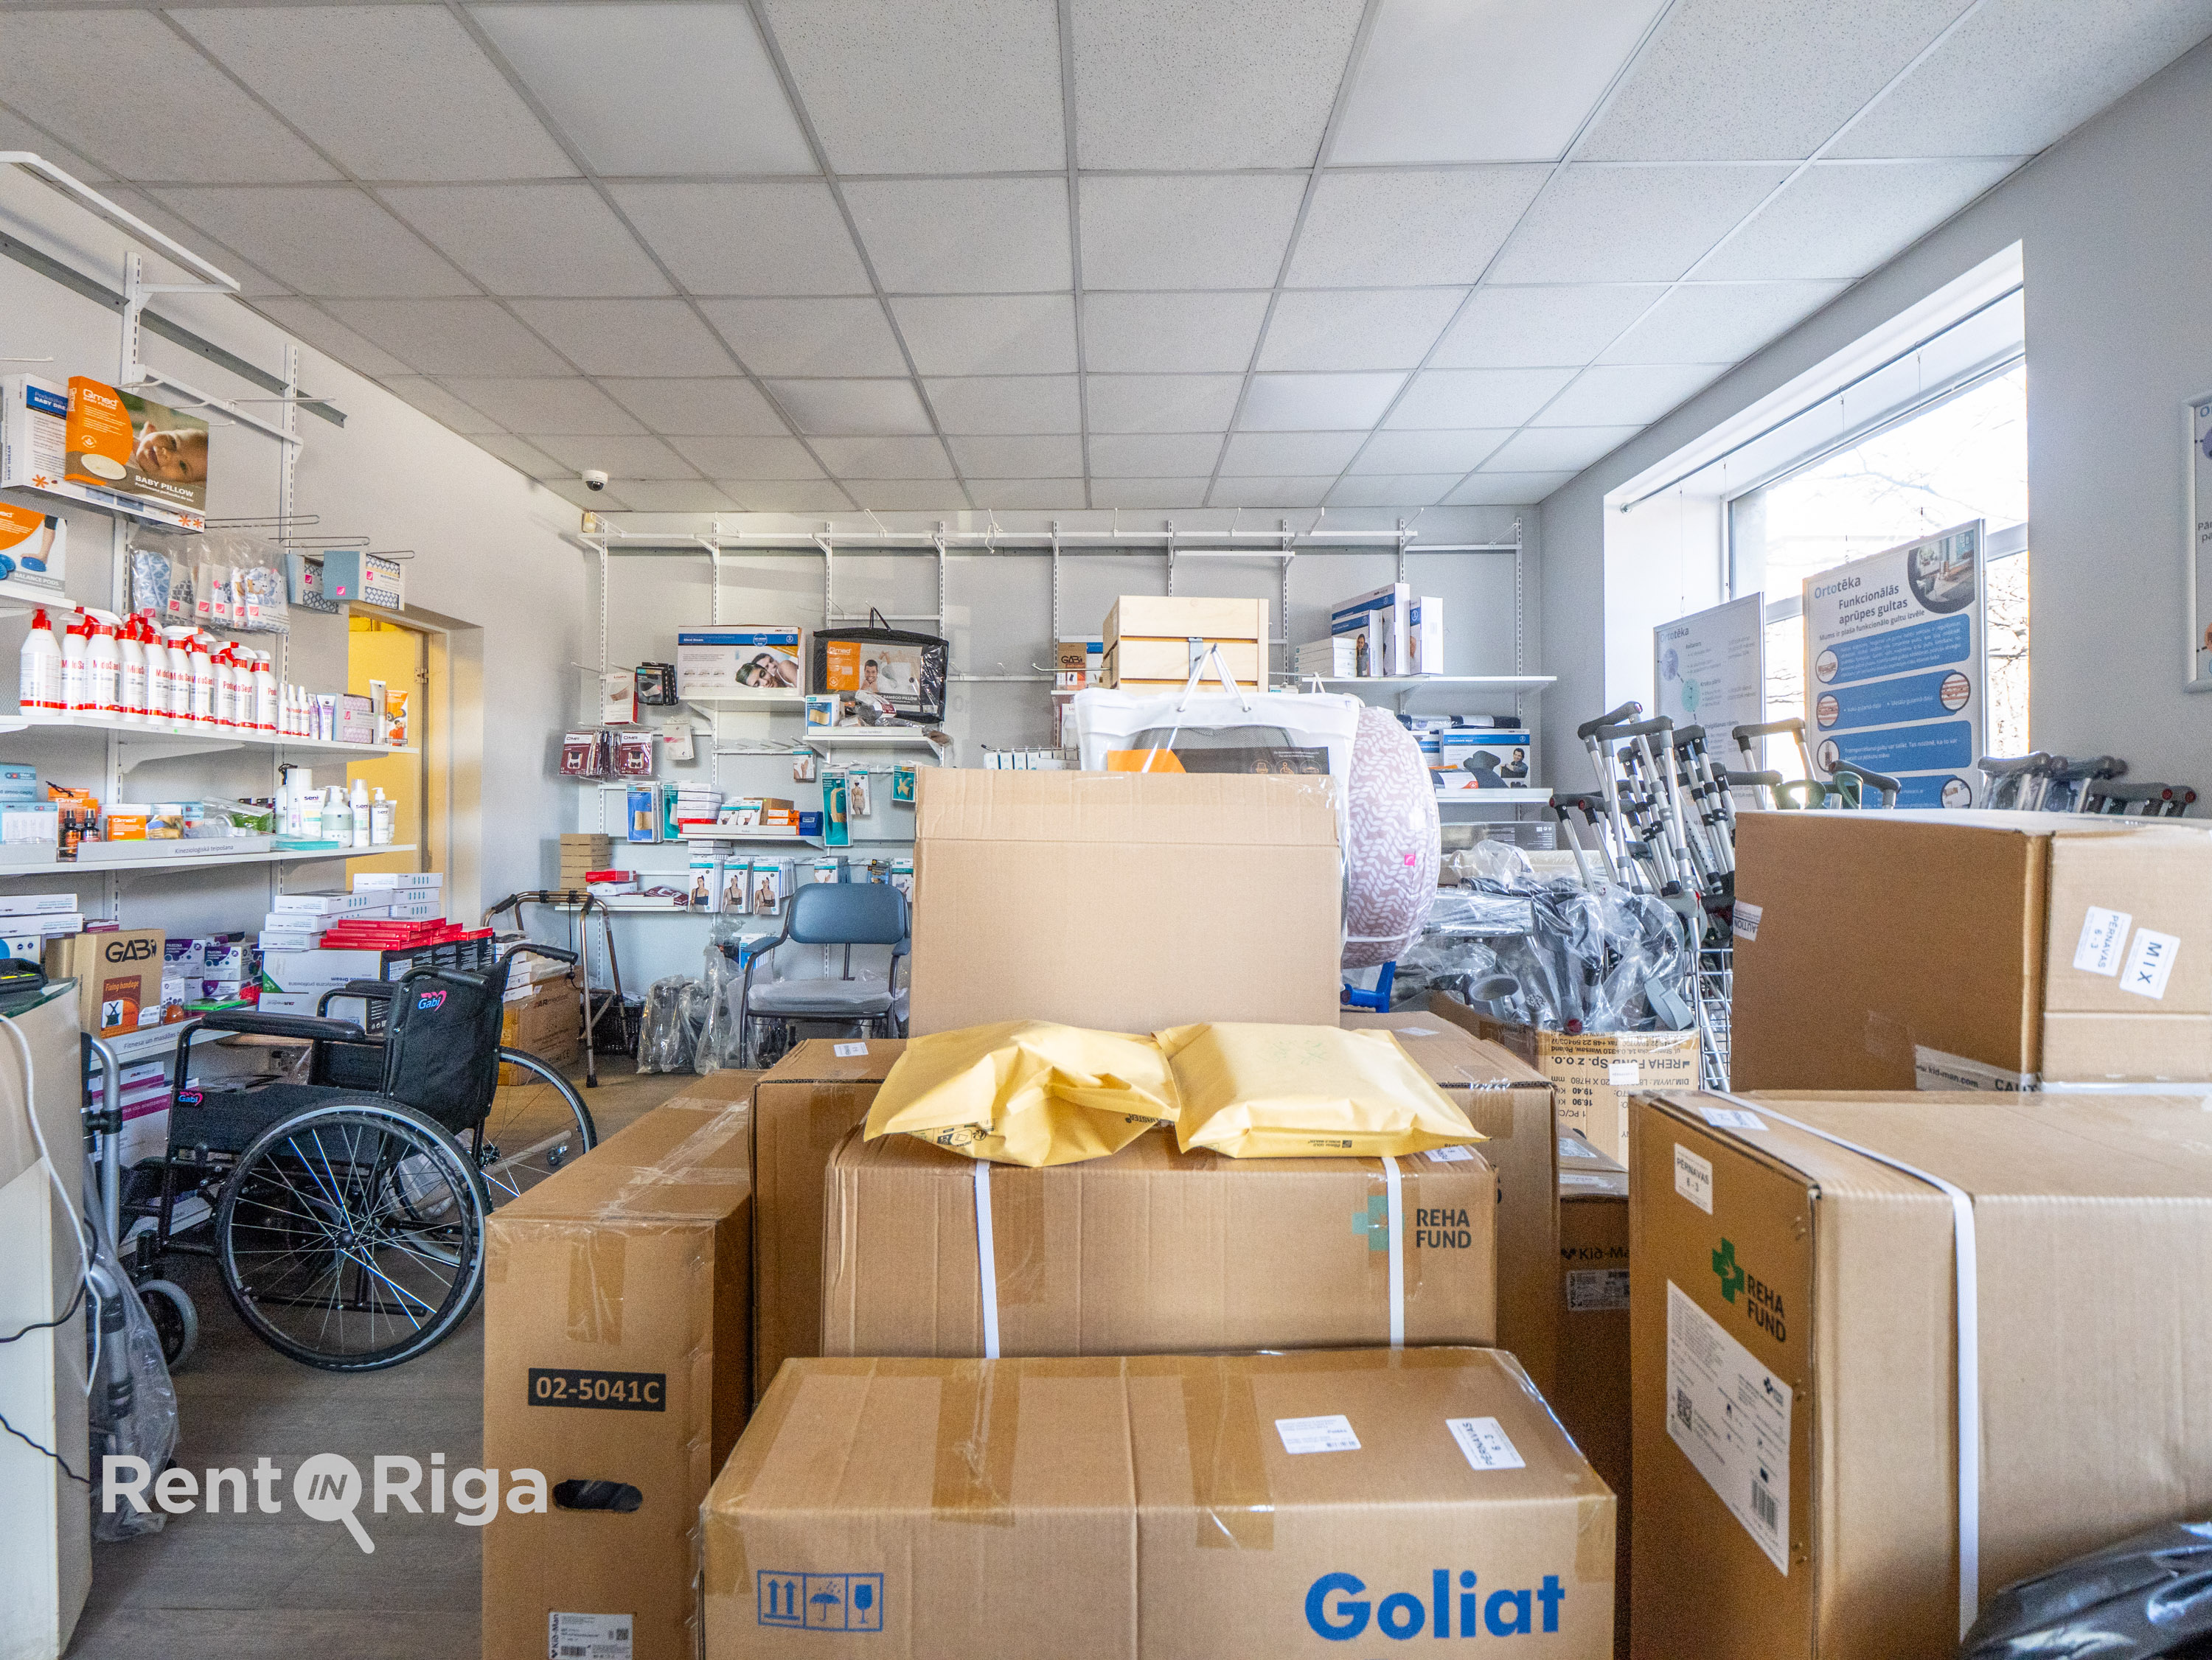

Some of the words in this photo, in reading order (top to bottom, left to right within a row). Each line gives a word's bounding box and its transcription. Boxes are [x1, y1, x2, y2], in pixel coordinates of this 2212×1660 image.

[35, 397, 52, 406] BABY
[83, 388, 118, 408] Qmed
[135, 475, 160, 487] BABY
[161, 483, 194, 498] PILLOW
[15, 572, 43, 583] BALANCE
[1815, 576, 1862, 599] Ortotēka
[1838, 585, 1900, 610] Funkcionālās
[1838, 608, 1877, 626] aprūpes
[1877, 599, 1909, 618] gultas
[1819, 632, 1835, 642] Mums
[829, 646, 851, 655] Qmed
[1734, 919, 1758, 934] AUTION
[105, 983, 119, 992] Fixing
[119, 980, 139, 990] bandage
[418, 997, 442, 1010] Gabi
[123, 1040, 145, 1050] Fitnesa
[1577, 1057, 1585, 1065] z
[1588, 1056, 1609, 1069] Sp.
[1649, 1059, 1681, 1069] REHA
[1573, 1087, 1593, 1095] 19.40
[178, 1095, 198, 1103] Gabi
[1416, 1208, 1470, 1227] REHA
[1416, 1230, 1472, 1249] FUND
[1747, 1273, 1785, 1319] REHA
[1747, 1298, 1787, 1342] FUND
[535, 1375, 661, 1403] 02-5041C
[1305, 1569, 1565, 1639] Goliat
